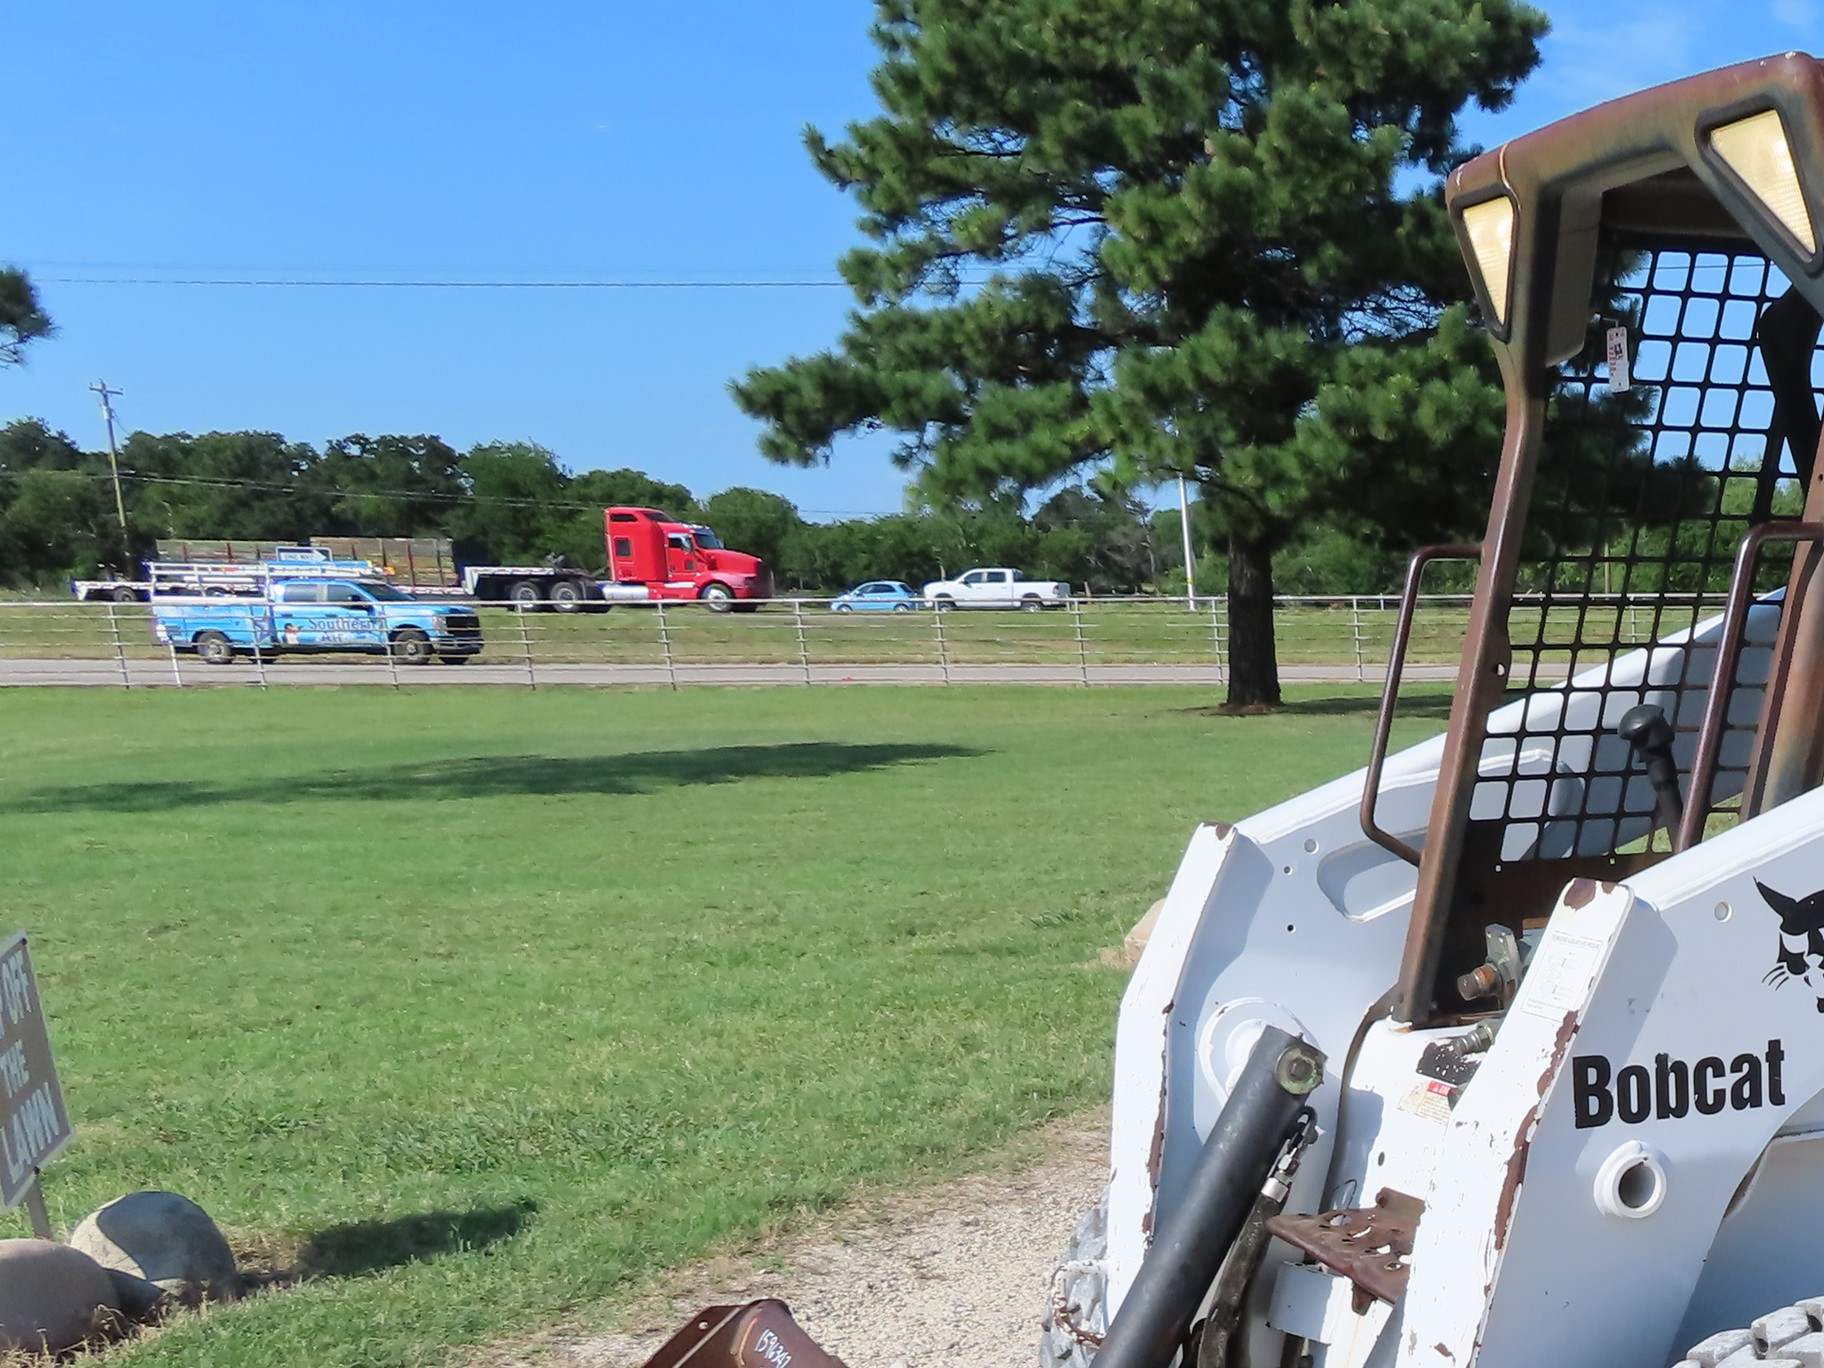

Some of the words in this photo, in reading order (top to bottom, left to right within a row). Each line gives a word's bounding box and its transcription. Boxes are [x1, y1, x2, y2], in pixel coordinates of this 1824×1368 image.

[308, 617, 375, 630] Southern
[0, 1039, 30, 1098] THE
[1572, 1038, 1786, 1130] Bobcat
[0, 1082, 60, 1184] LAWN
